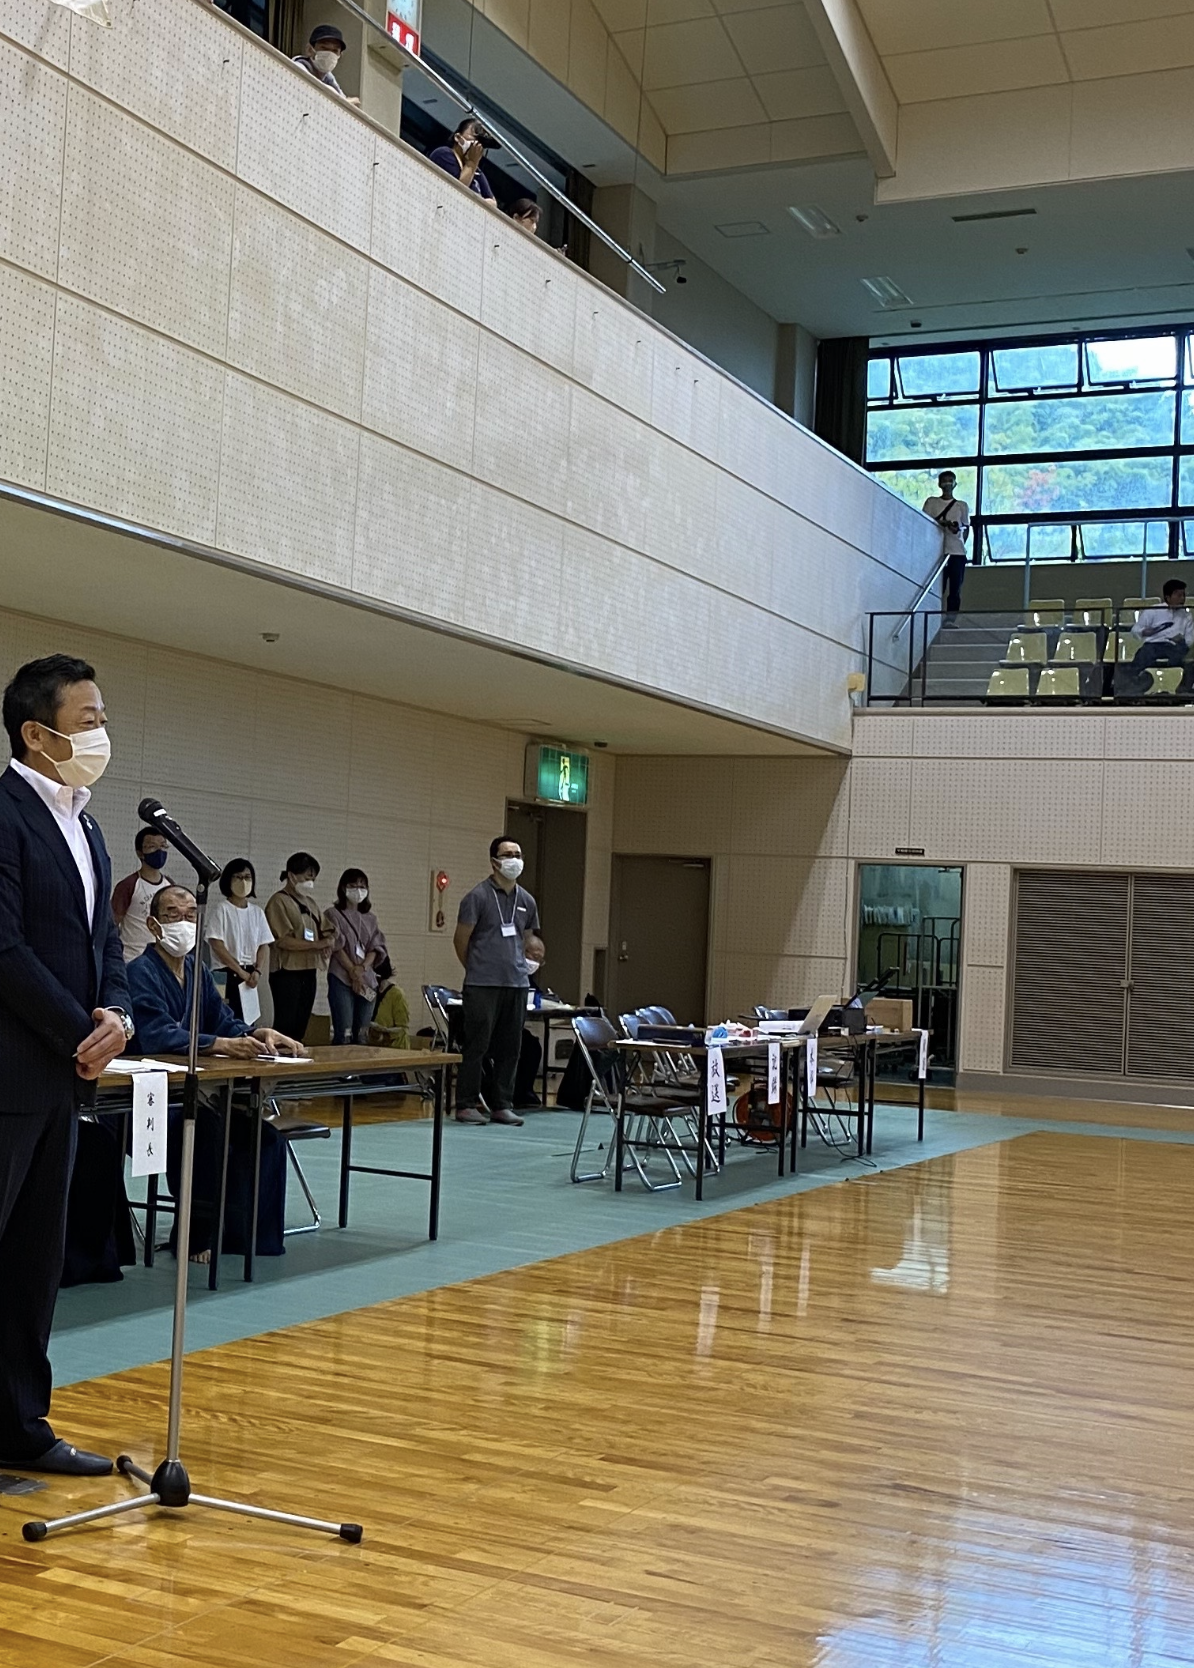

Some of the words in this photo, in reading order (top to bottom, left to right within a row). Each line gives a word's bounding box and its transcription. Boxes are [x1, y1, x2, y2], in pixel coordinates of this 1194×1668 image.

[711, 1059, 721, 1103] 放送
[146, 1092, 155, 1157] 審判長
